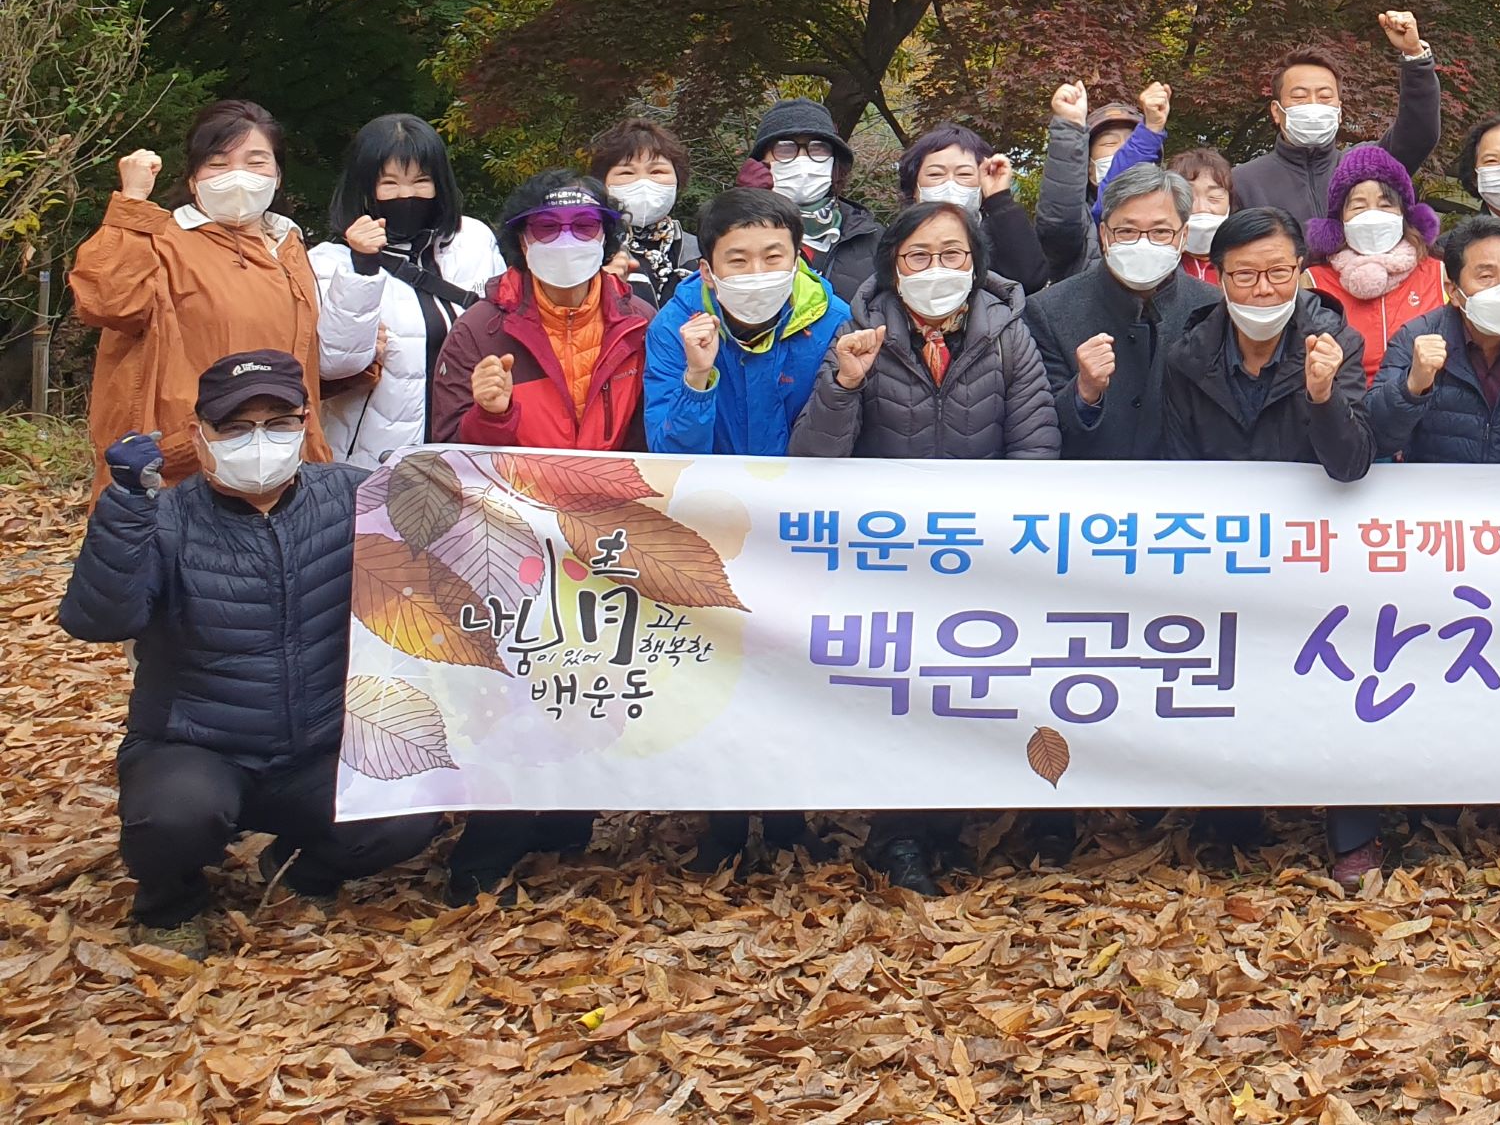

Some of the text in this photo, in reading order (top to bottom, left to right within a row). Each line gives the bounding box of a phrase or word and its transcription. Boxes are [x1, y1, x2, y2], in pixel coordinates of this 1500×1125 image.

[778, 510, 984, 577] 백운동
[1009, 512, 1339, 577] 지역주민과
[638, 632, 714, 668] 행복한
[807, 610, 1238, 723] 백운공원
[531, 668, 653, 720] 백운동
